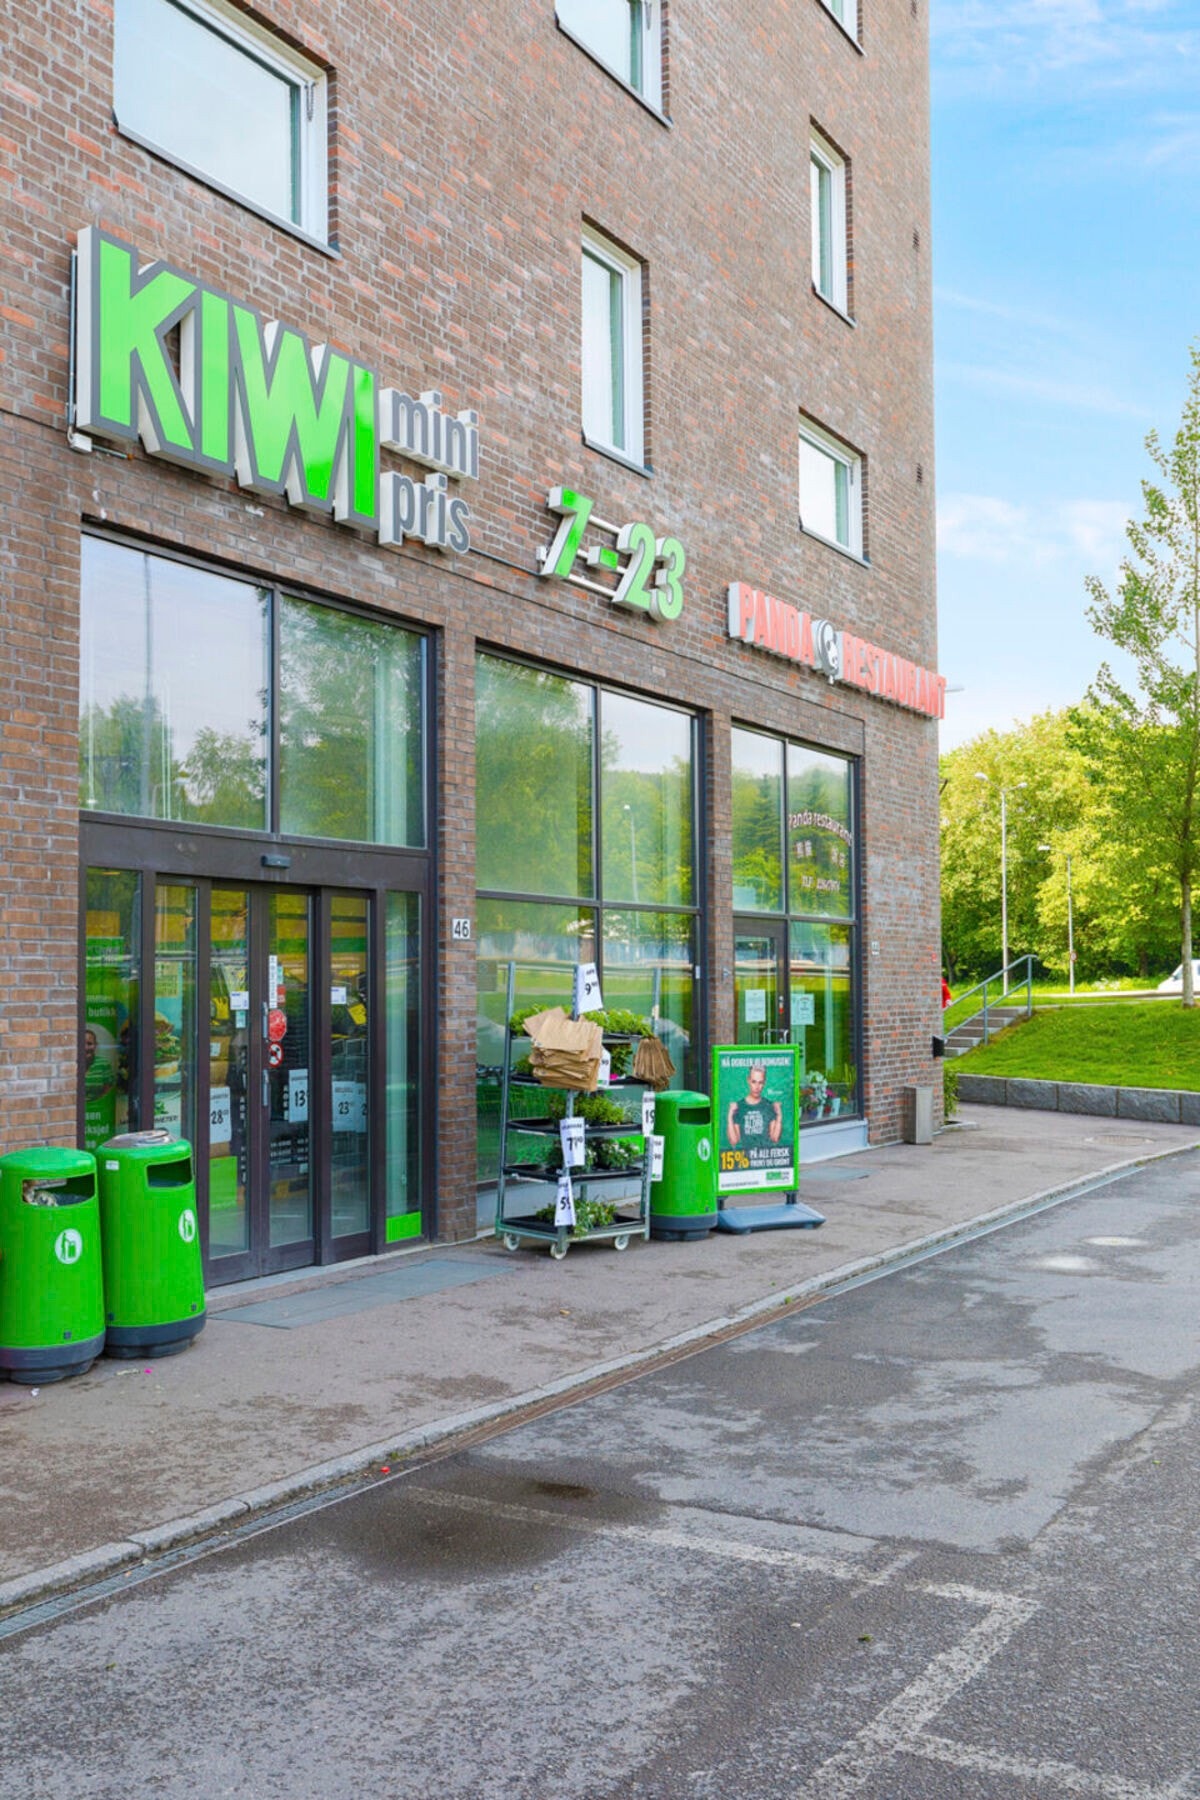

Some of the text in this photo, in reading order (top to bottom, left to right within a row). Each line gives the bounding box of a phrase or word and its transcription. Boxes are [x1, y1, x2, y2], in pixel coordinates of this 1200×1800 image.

[78, 226, 379, 532] KIWI
[381, 388, 479, 480] mini
[381, 472, 470, 553] pris
[730, 582, 946, 719] PANDA RESTAURANT
[454, 920, 469, 937] 46
[209, 1110, 223, 1125] 28
[720, 1150, 750, 1170] 15%
